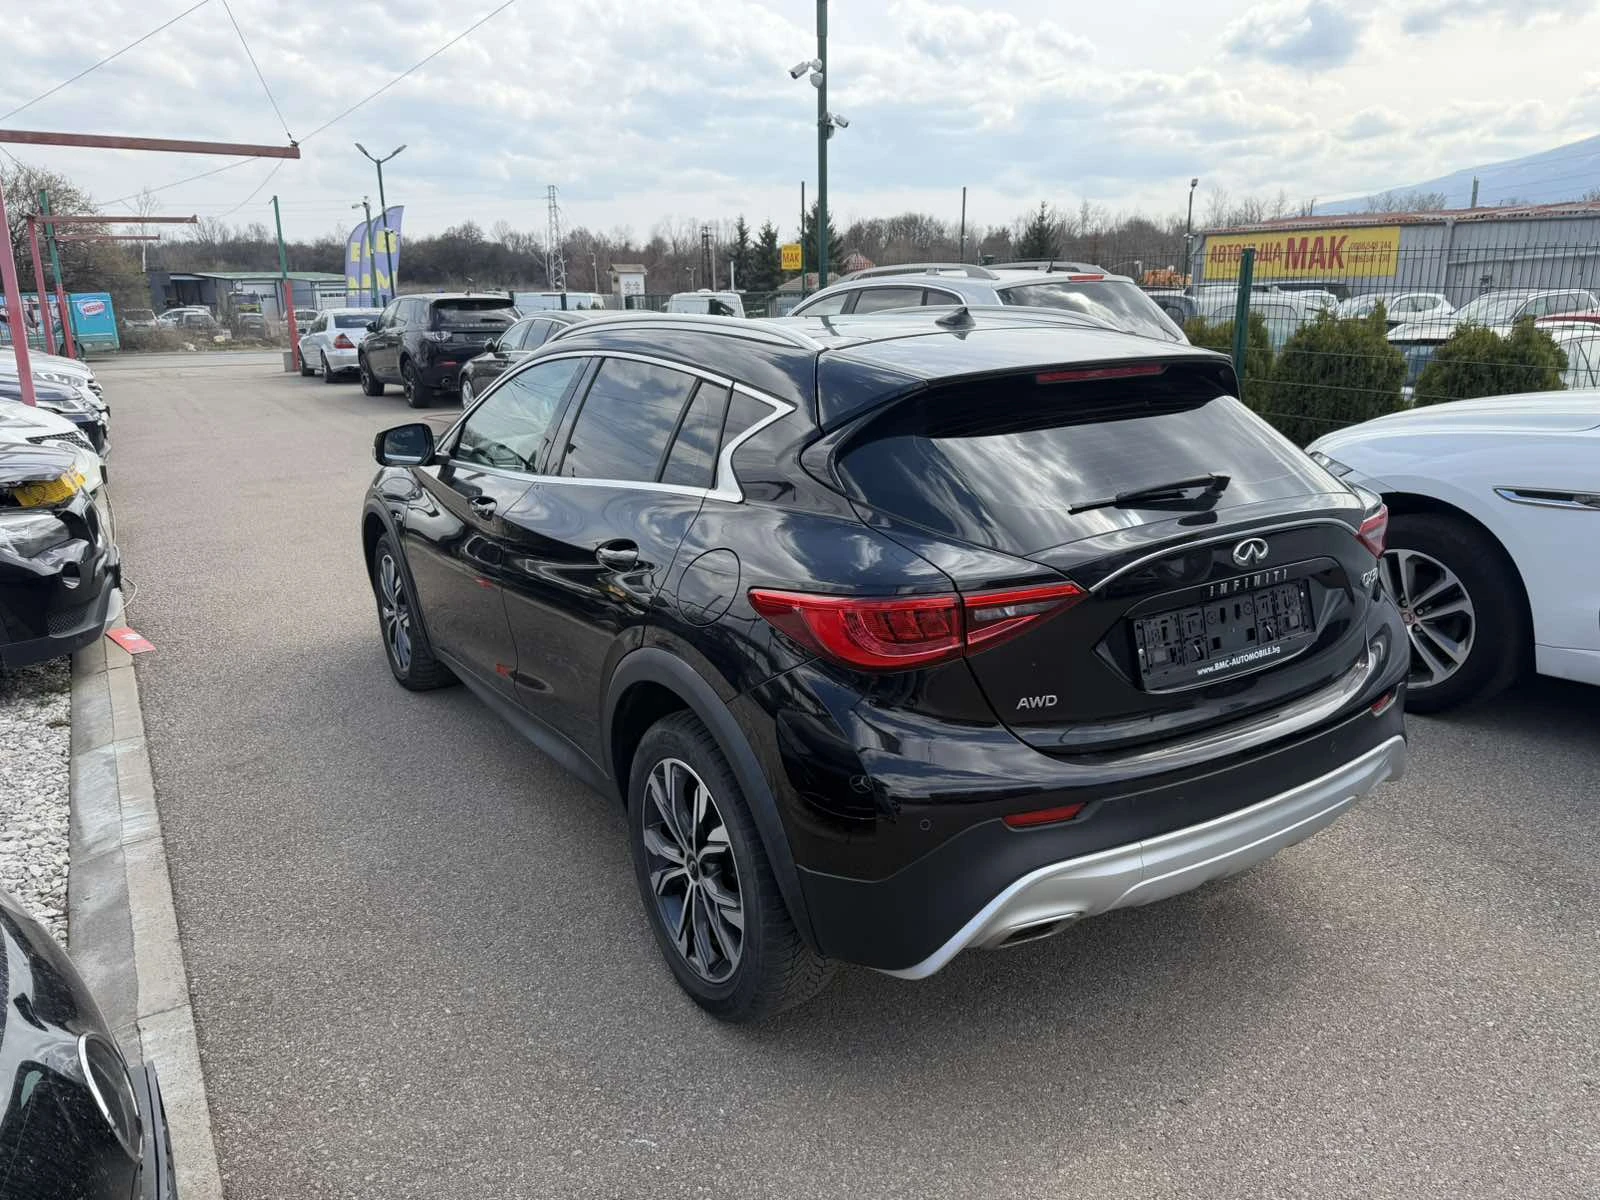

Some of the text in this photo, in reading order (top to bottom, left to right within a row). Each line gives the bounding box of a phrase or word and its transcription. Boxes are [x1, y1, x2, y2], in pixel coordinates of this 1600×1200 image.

[1210, 235, 1348, 270] АВТОЪЩА МАК
[1210, 569, 1287, 596] INFINITI
[1362, 568, 1378, 588] QX3
[1197, 645, 1281, 675] www.BMC-AUTOMOBILE.bg
[1016, 695, 1058, 710] AWD
